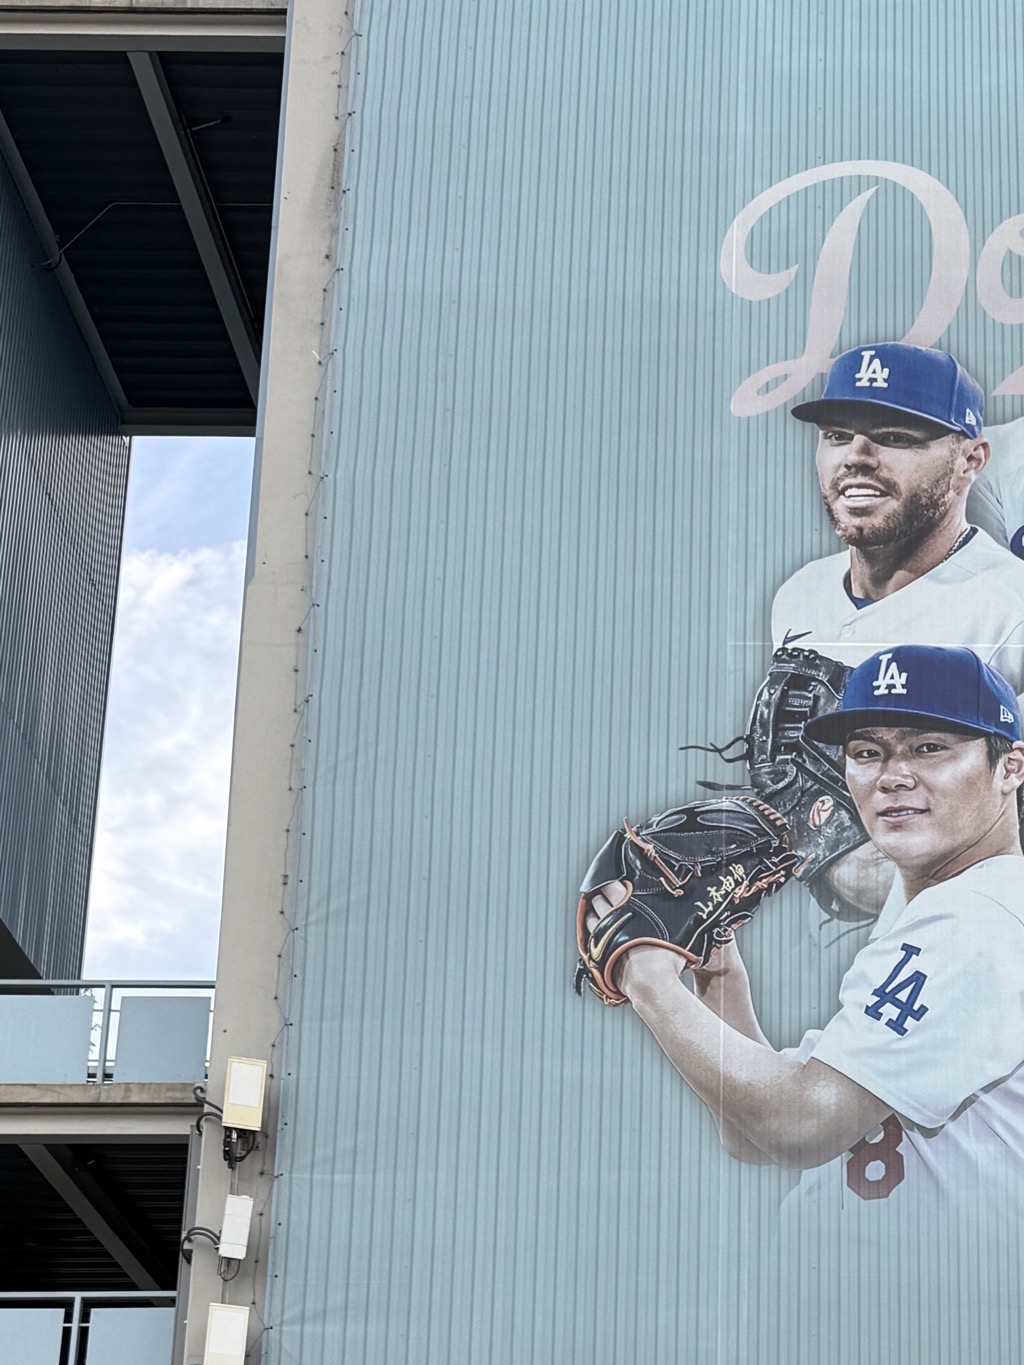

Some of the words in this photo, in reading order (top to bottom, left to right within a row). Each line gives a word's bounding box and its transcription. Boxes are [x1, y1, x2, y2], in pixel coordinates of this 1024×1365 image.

[855, 350, 889, 388] LA
[872, 653, 907, 696] LA
[864, 942, 929, 1036] LA
